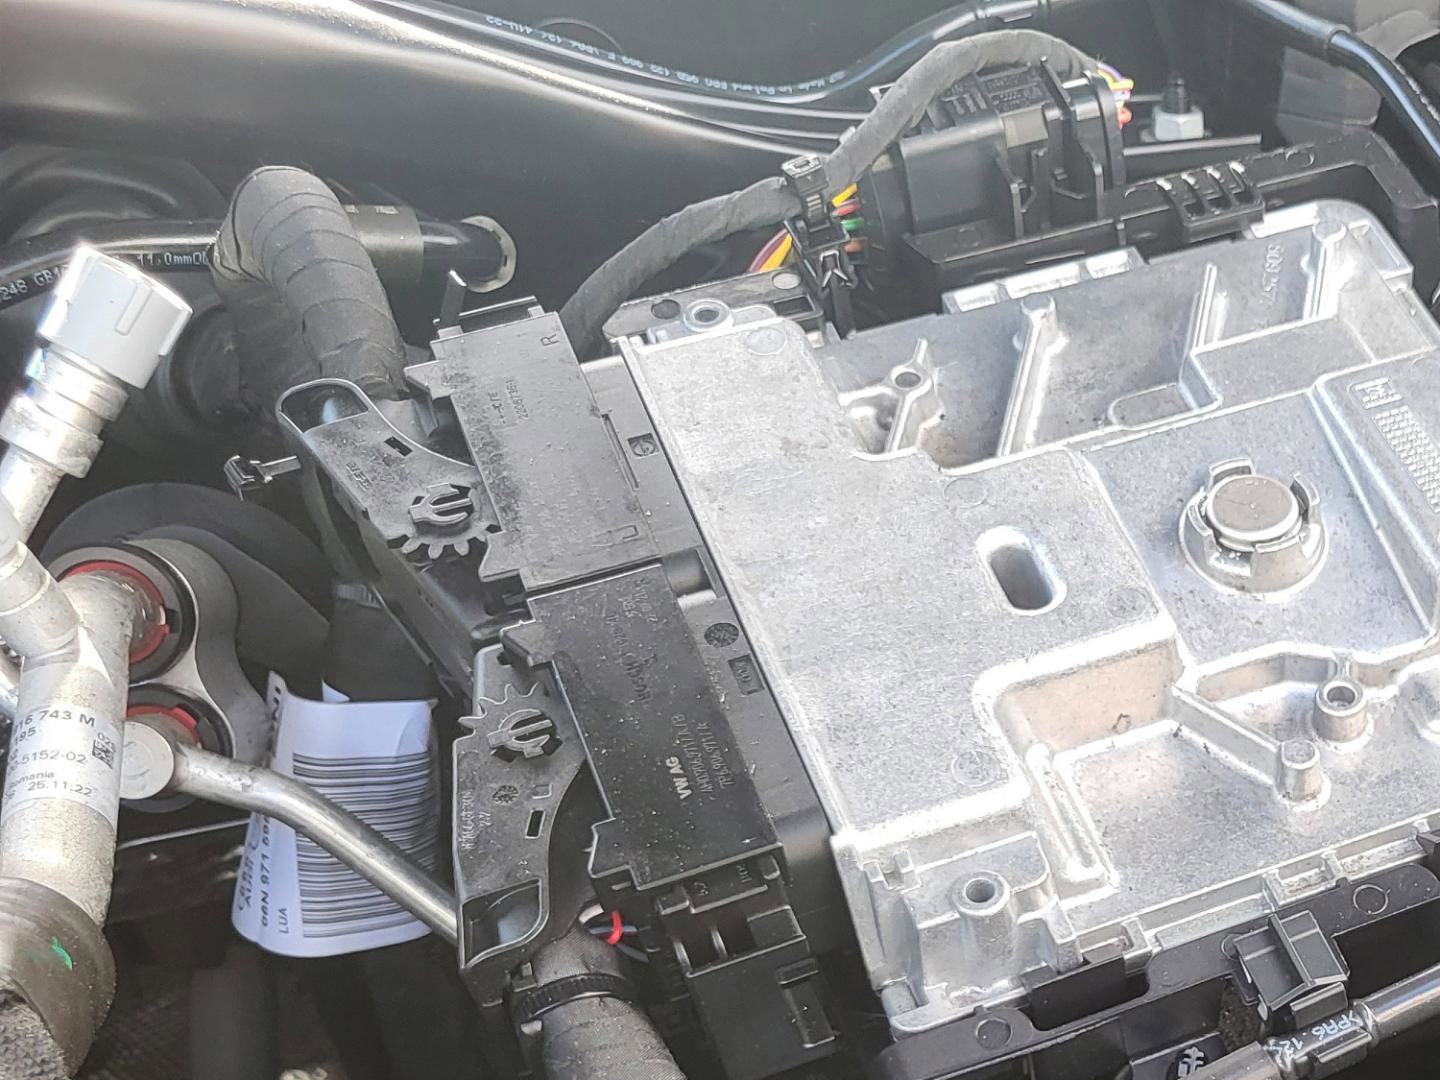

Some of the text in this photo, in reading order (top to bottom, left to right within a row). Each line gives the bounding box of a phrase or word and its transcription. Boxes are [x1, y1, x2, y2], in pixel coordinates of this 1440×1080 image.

[540, 333, 560, 347] R
[39, 709, 72, 721] 743
[79, 713, 96, 728] M
[665, 756, 692, 800] VW AG
[277, 907, 289, 934] LUA
